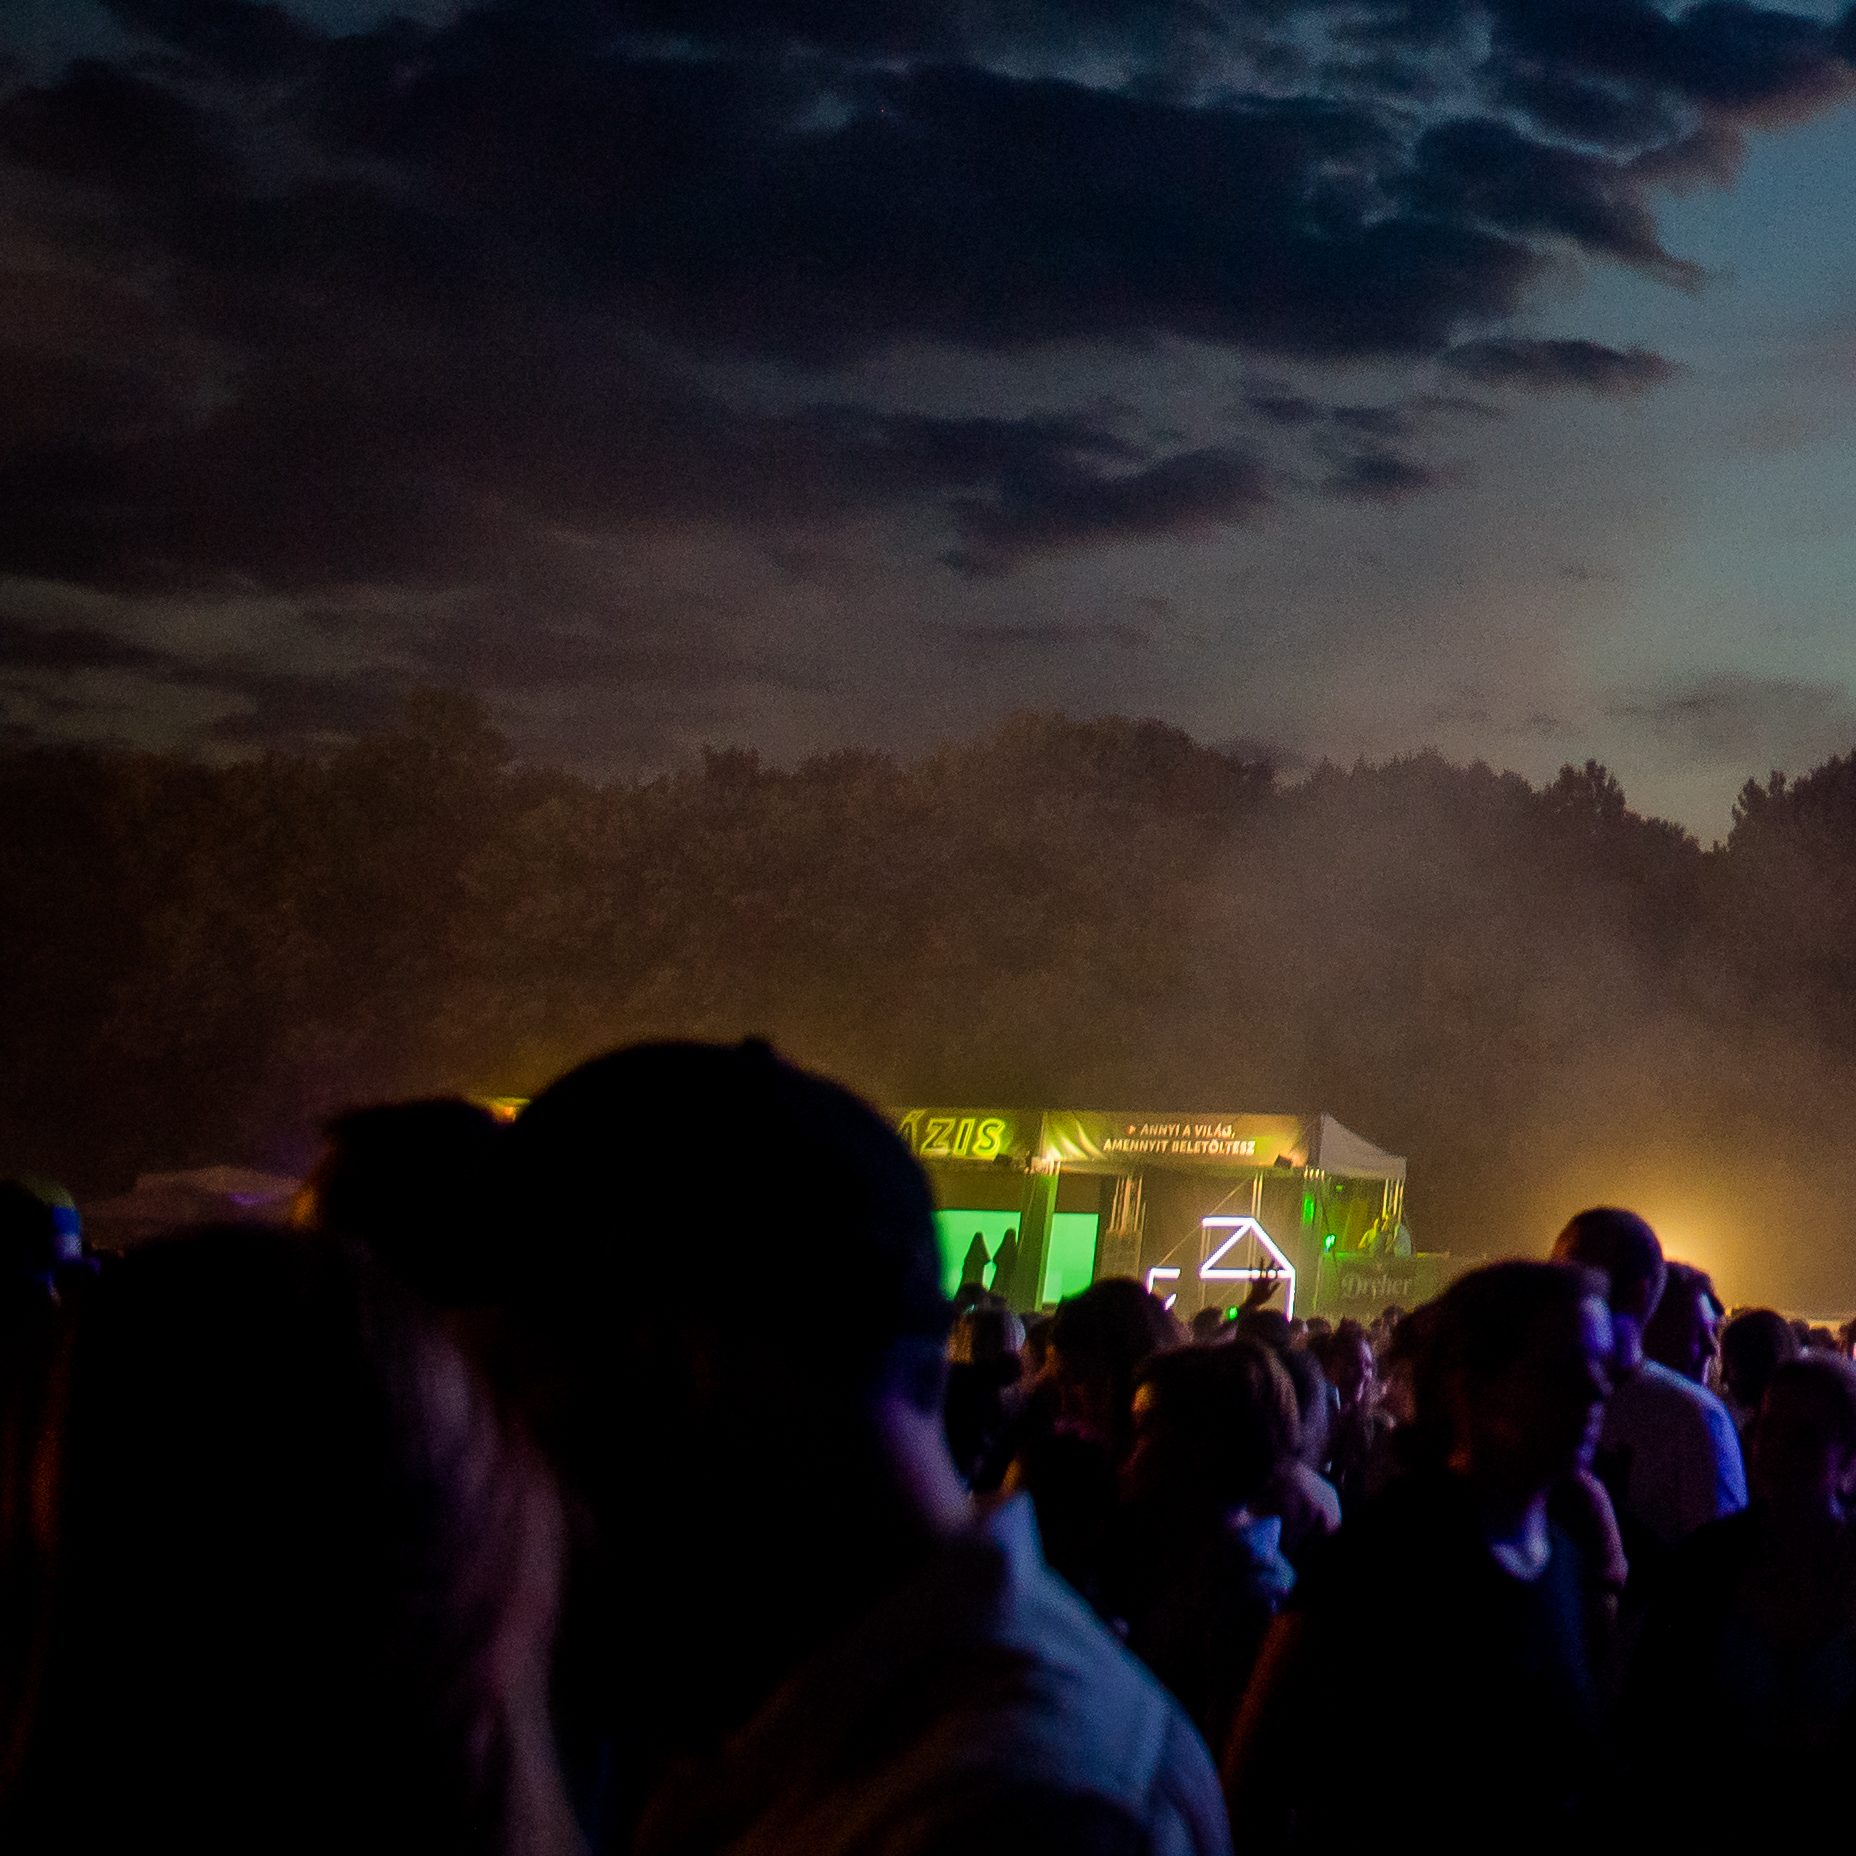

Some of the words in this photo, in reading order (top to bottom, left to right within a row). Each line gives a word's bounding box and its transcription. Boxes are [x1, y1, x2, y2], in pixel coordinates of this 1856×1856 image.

[1140, 1123, 1180, 1137] ANNYI
[1182, 1124, 1191, 1137] A
[1194, 1122, 1236, 1139] VILÁG,
[1103, 1138, 1169, 1153] AMENNYIT
